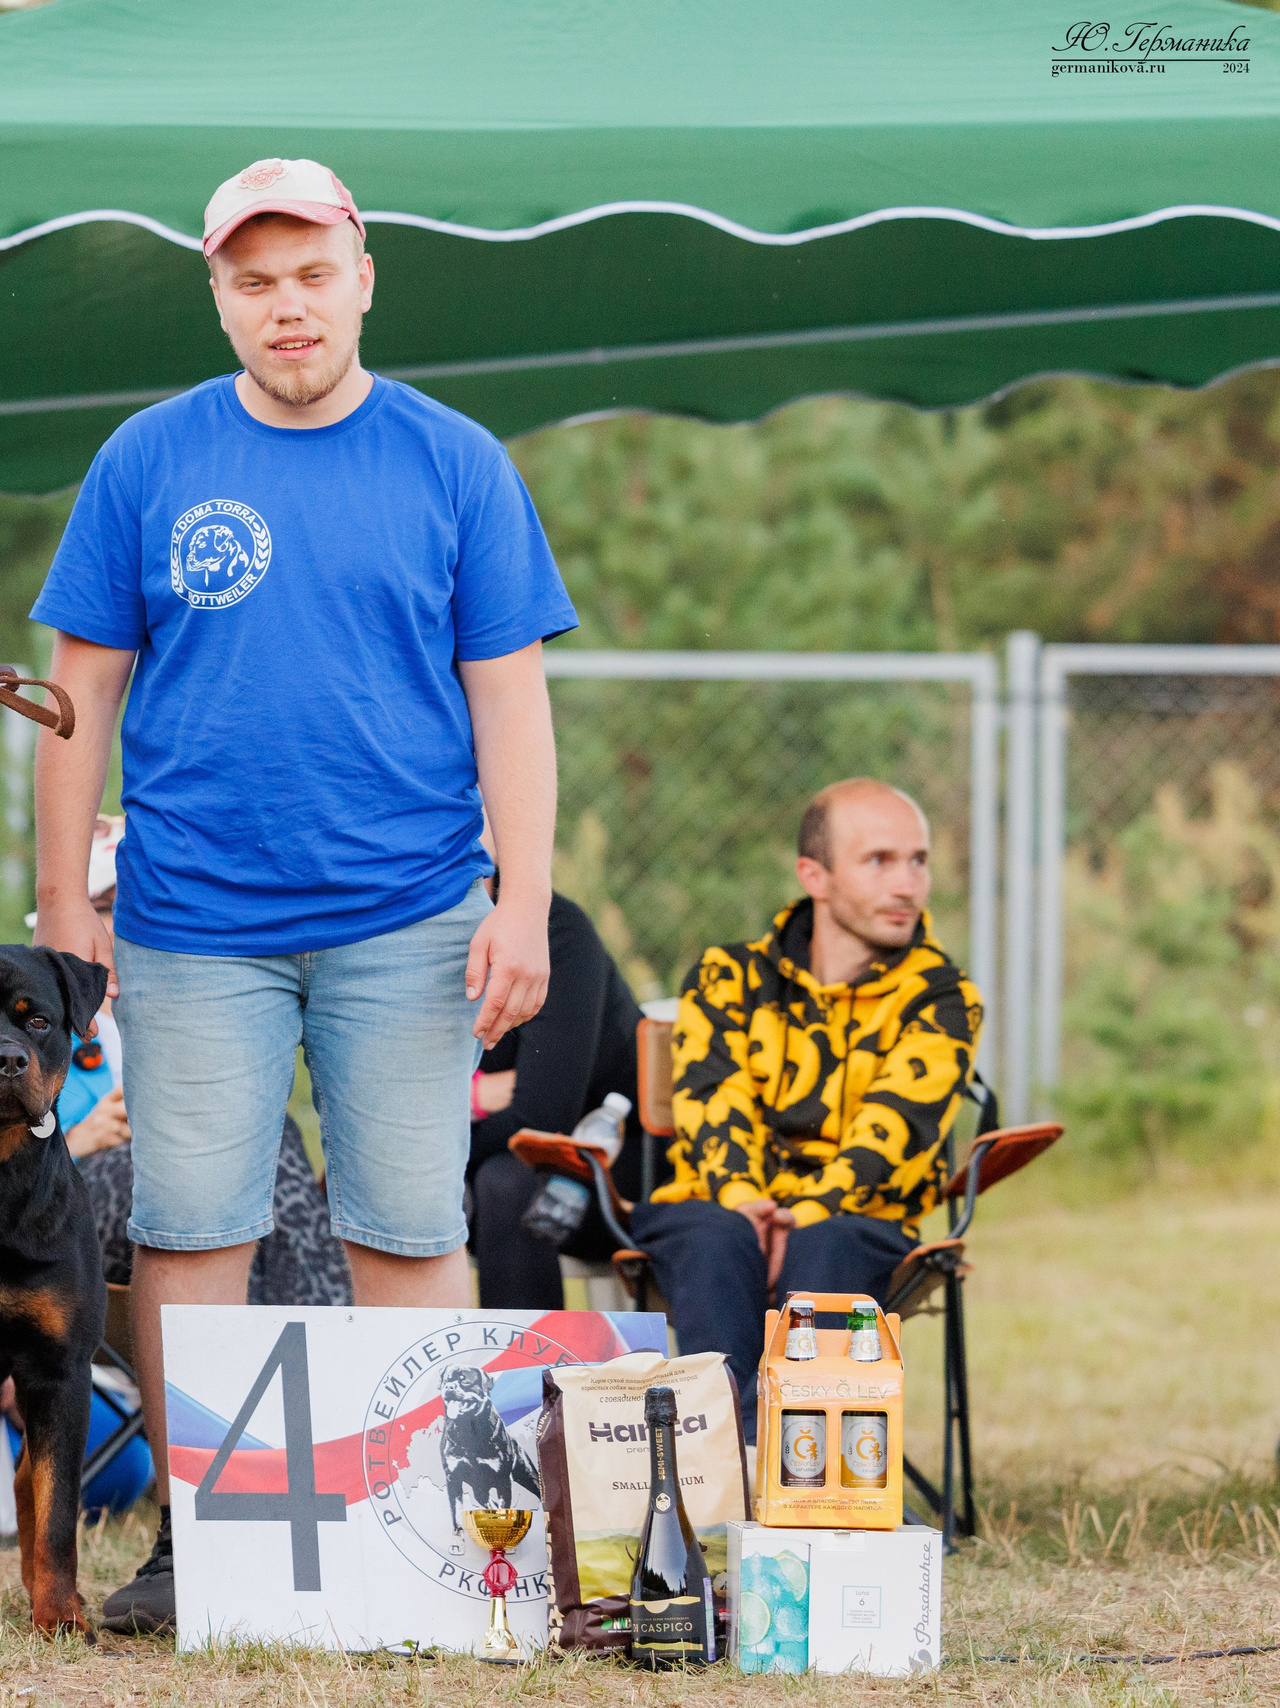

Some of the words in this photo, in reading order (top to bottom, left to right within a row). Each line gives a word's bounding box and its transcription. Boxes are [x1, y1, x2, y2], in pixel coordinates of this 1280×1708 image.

[177, 504, 213, 531] DOMA
[215, 502, 256, 525] TORRA
[368, 1331, 462, 1527] РОТВЕЙЛЕР
[194, 1321, 347, 1592] 4
[655, 1427, 664, 1481] SEMI-SWEET
[613, 1480, 650, 1490] SMALL
[859, 1597, 865, 1606] 6
[640, 1621, 693, 1633] CASPICO
